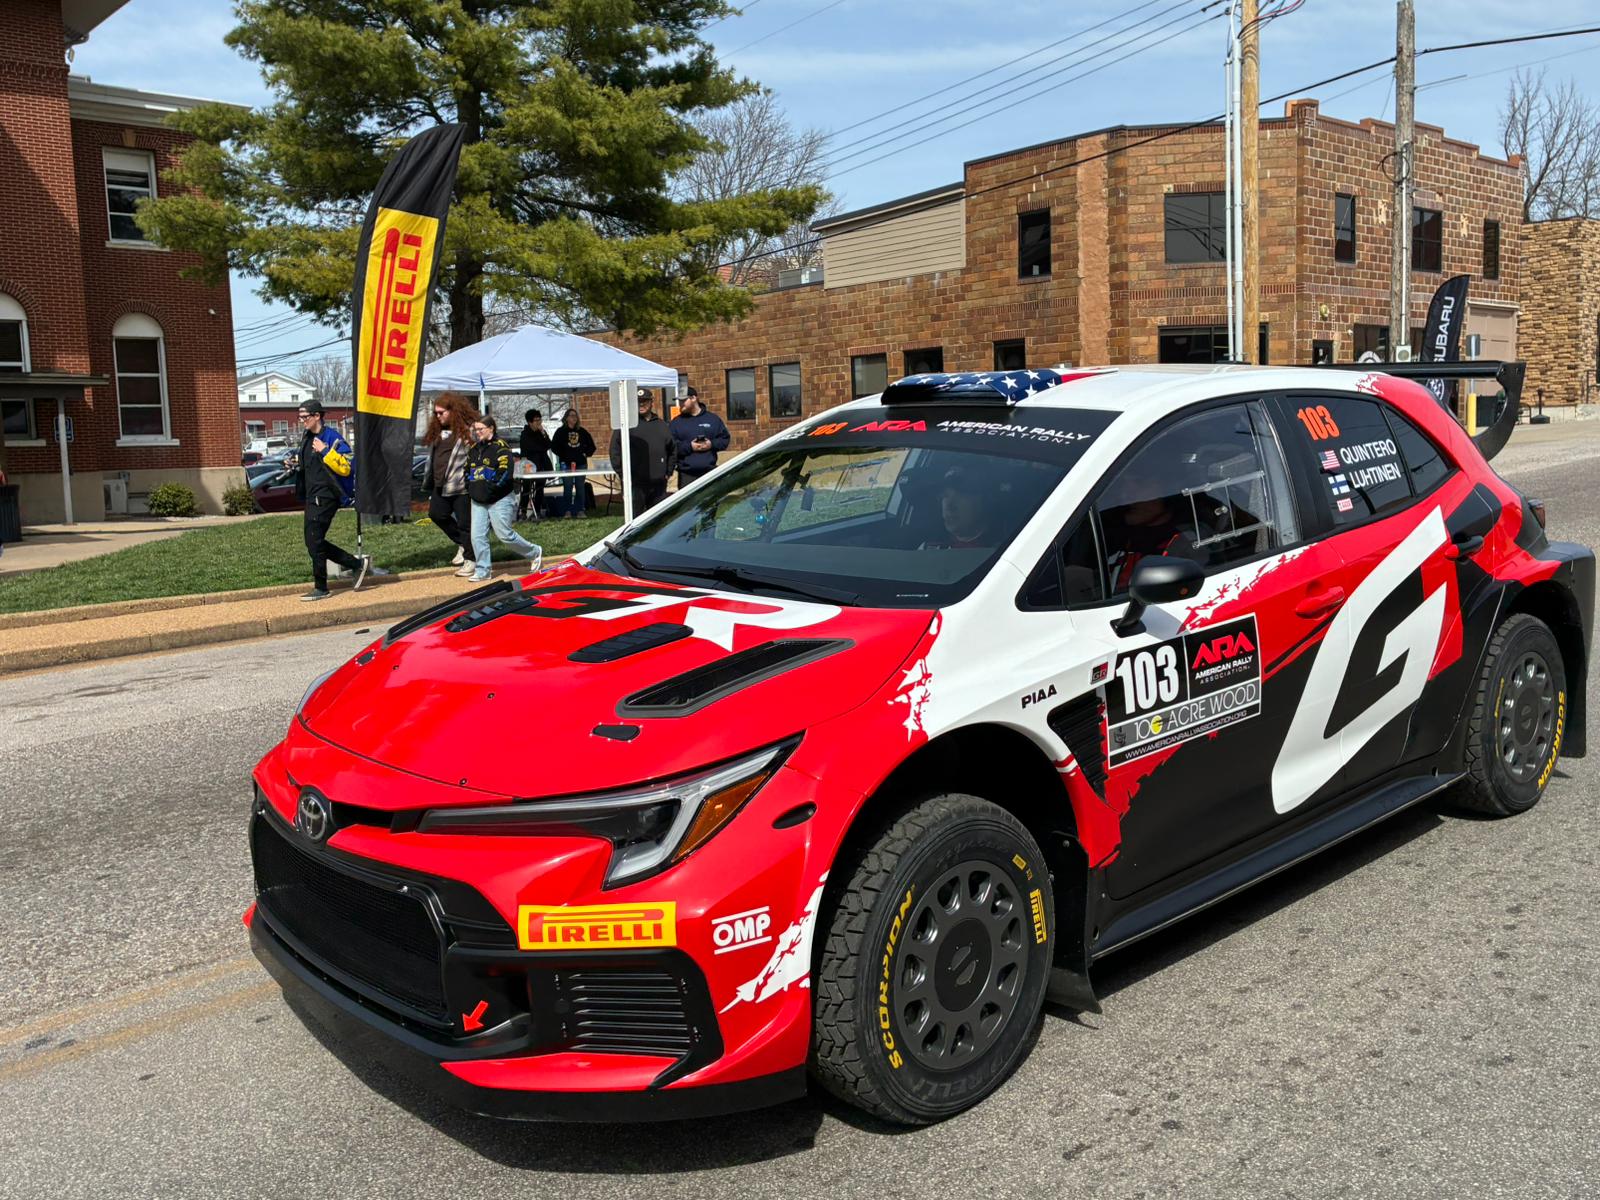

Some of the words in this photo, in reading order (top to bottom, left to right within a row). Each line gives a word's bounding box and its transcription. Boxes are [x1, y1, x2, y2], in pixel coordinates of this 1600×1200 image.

[367, 228, 422, 400] PIRELLI
[937, 421, 1028, 433] AMERICAN
[1030, 427, 1091, 441] RALLY
[1297, 405, 1340, 440] 103
[1340, 438, 1397, 464] QUINTERO
[1349, 462, 1401, 489] LUHTINEN
[1116, 645, 1179, 714] 103
[1195, 662, 1232, 680] AMERICAN
[1232, 655, 1253, 668] RALLY
[1021, 684, 1057, 709] PIAA
[1167, 701, 1206, 731] ACRE
[1209, 683, 1257, 714] WOOD
[1125, 710, 1248, 760] WWW.AMERICANRALLYASSOCIATION.ORG
[1538, 691, 1565, 790] SCORPION
[528, 909, 664, 943] PIRELLI
[713, 913, 771, 947] OMP
[1029, 888, 1047, 944] PIRELLI
[879, 890, 911, 1070] SCORPION
